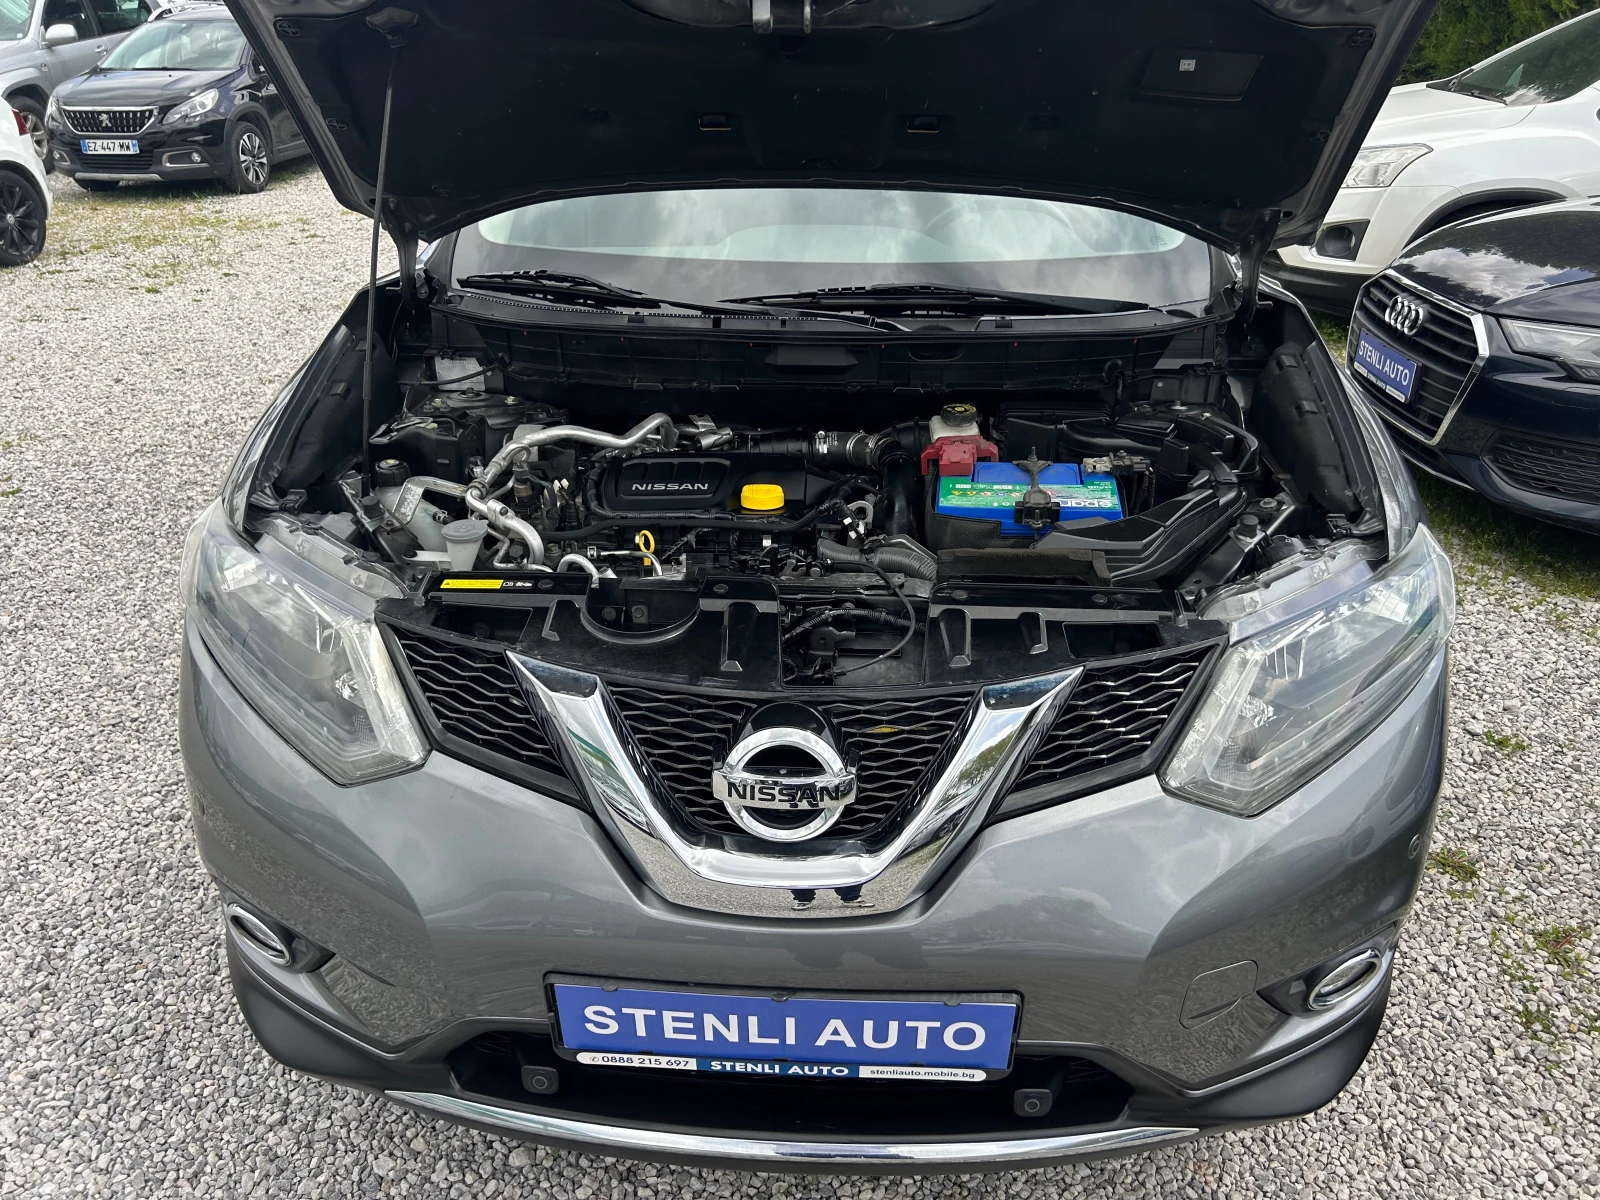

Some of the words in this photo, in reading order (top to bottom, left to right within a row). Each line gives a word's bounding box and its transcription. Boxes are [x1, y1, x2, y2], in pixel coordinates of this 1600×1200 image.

[1359, 340, 1384, 370] STENLI
[1383, 359, 1409, 386] AUTO
[632, 483, 709, 491] NISSAN
[727, 782, 841, 803] NISSAN
[584, 1005, 796, 1045] STENLI
[815, 1018, 986, 1051] AUTO
[602, 1056, 634, 1064] 0888
[638, 1057, 662, 1066] 215
[711, 1061, 780, 1073] STENLI
[788, 1065, 849, 1076] AUTO
[870, 1069, 975, 1079] stenliauto.mobile.bg
